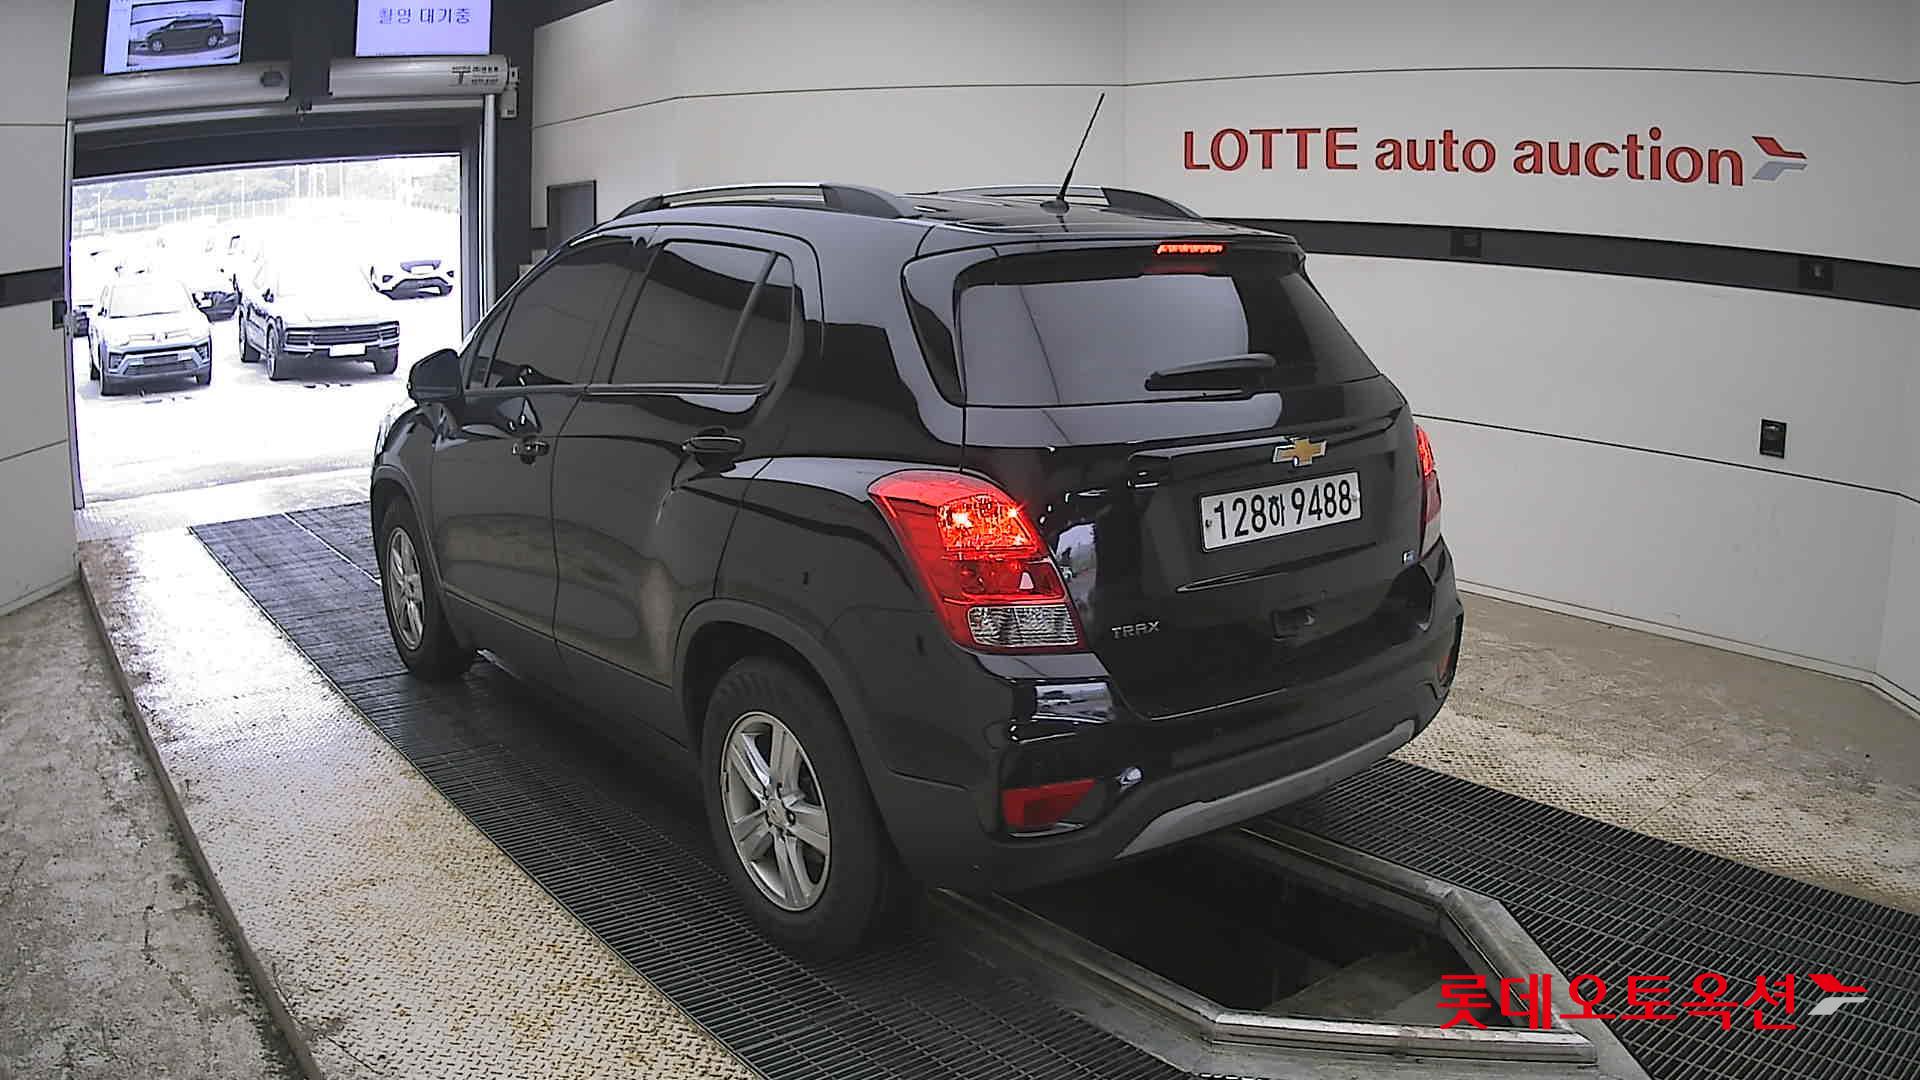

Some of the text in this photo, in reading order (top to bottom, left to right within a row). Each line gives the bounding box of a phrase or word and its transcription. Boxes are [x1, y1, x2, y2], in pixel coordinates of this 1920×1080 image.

[420, 8, 472, 24] 대기중
[1184, 126, 1744, 186] LOTTE auto auction
[1214, 479, 1353, 540] 128하 9488
[1111, 620, 1160, 640] TRAX
